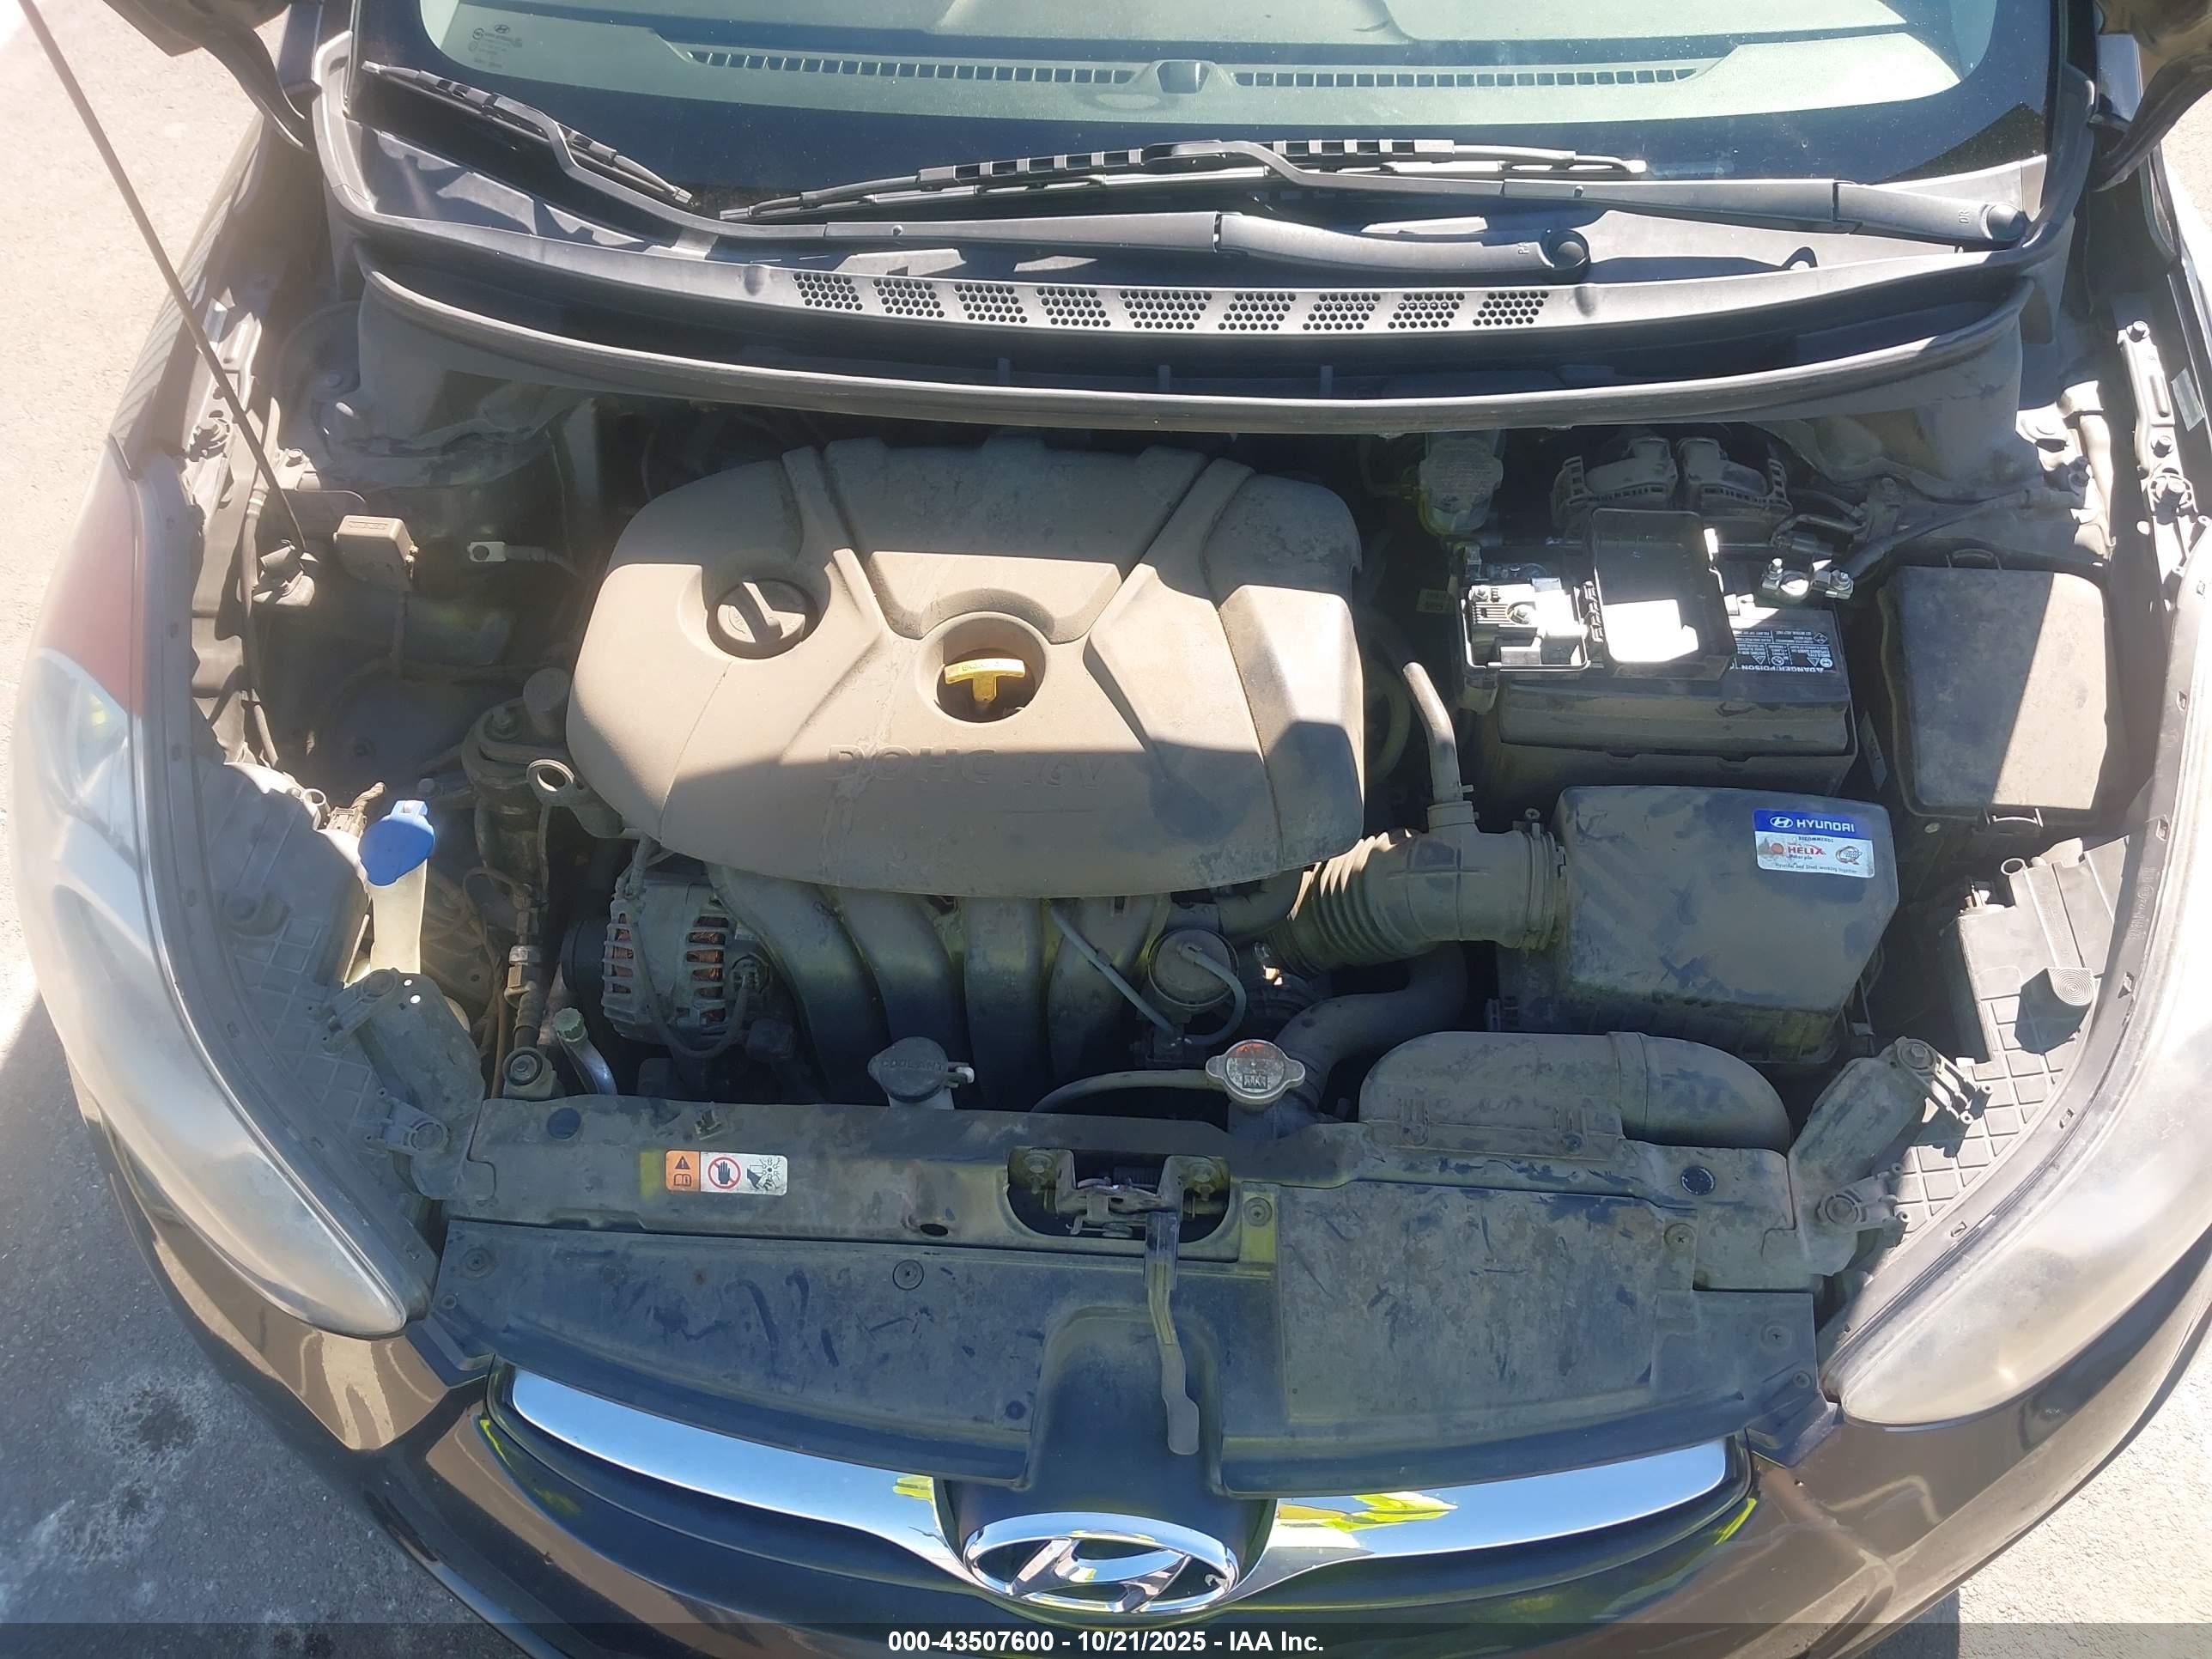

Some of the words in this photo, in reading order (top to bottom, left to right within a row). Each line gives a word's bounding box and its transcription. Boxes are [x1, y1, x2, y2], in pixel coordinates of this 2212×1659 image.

[830, 744, 995, 783] DOHC
[1796, 819, 1855, 832] HYUNDAI
[1788, 845, 1826, 855] HELIX
